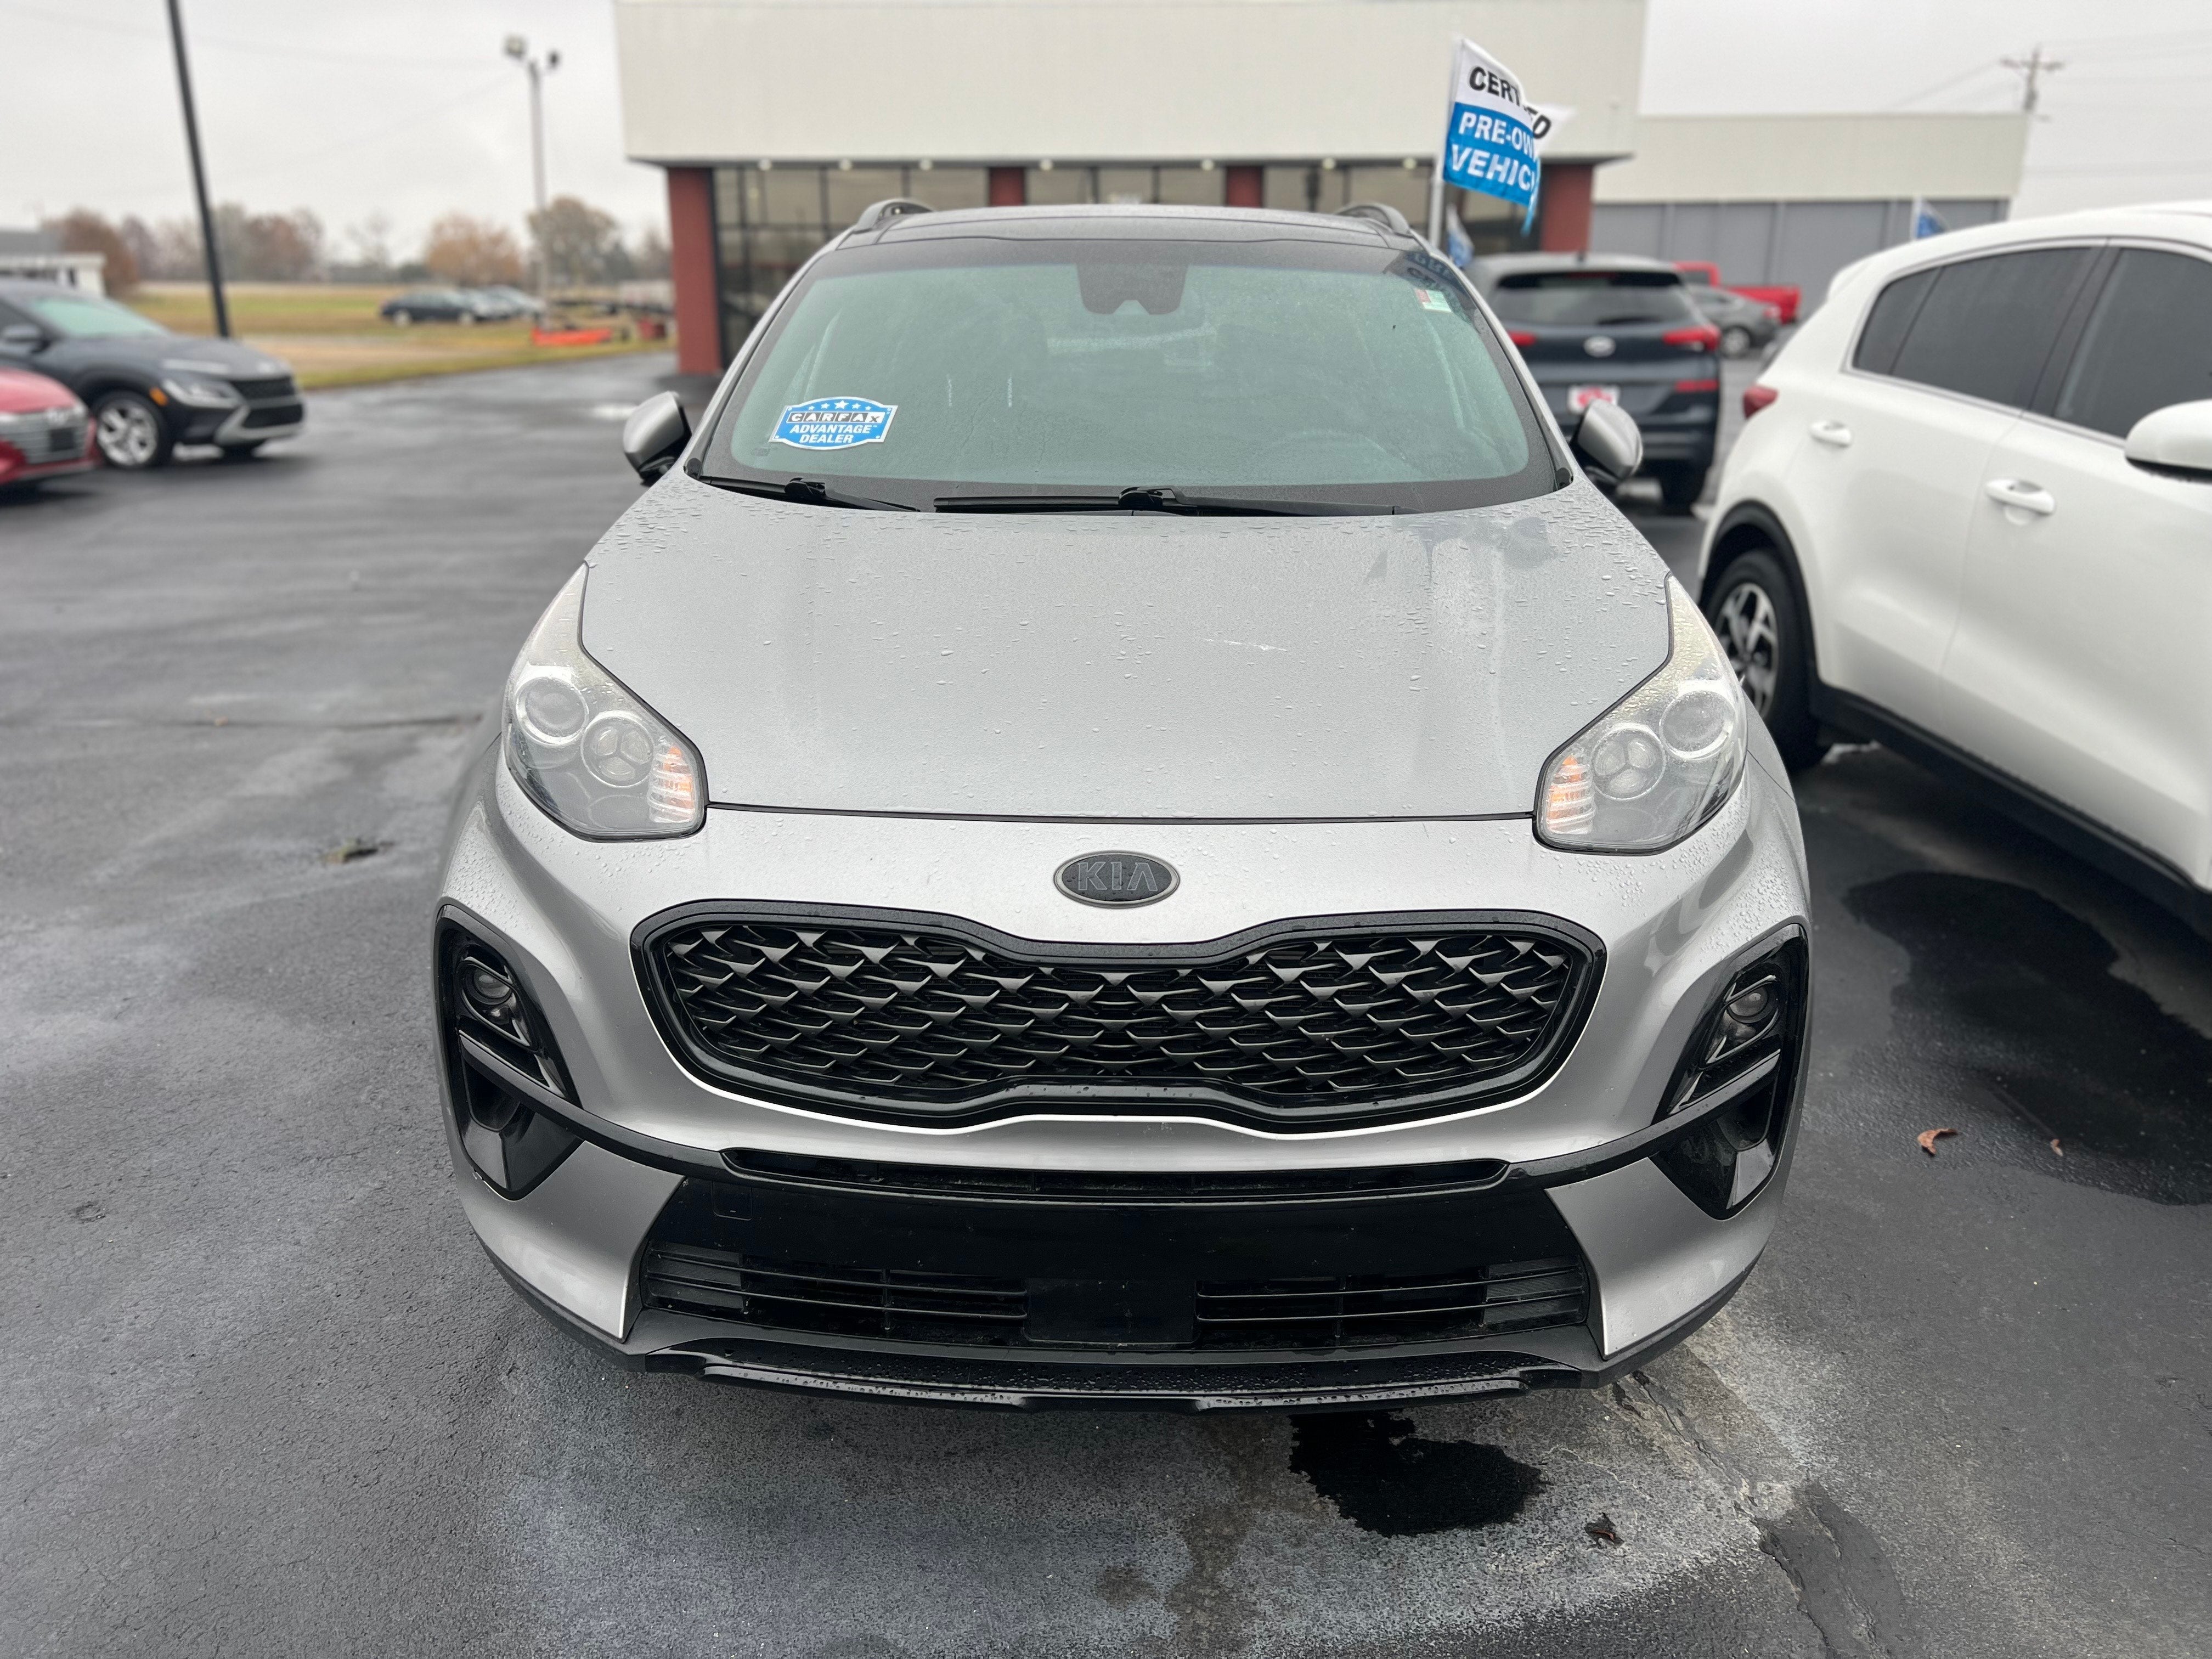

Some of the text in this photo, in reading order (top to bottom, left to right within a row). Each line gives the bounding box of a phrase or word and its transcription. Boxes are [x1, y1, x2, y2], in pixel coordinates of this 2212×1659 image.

[1458, 111, 1536, 162] PRE-OW
[1452, 144, 1535, 192] VEHIC
[788, 412, 882, 422] CARFAX
[789, 424, 872, 434] ADVANTAGE
[799, 434, 854, 443] DEALER
[1077, 861, 1158, 891] KIA
